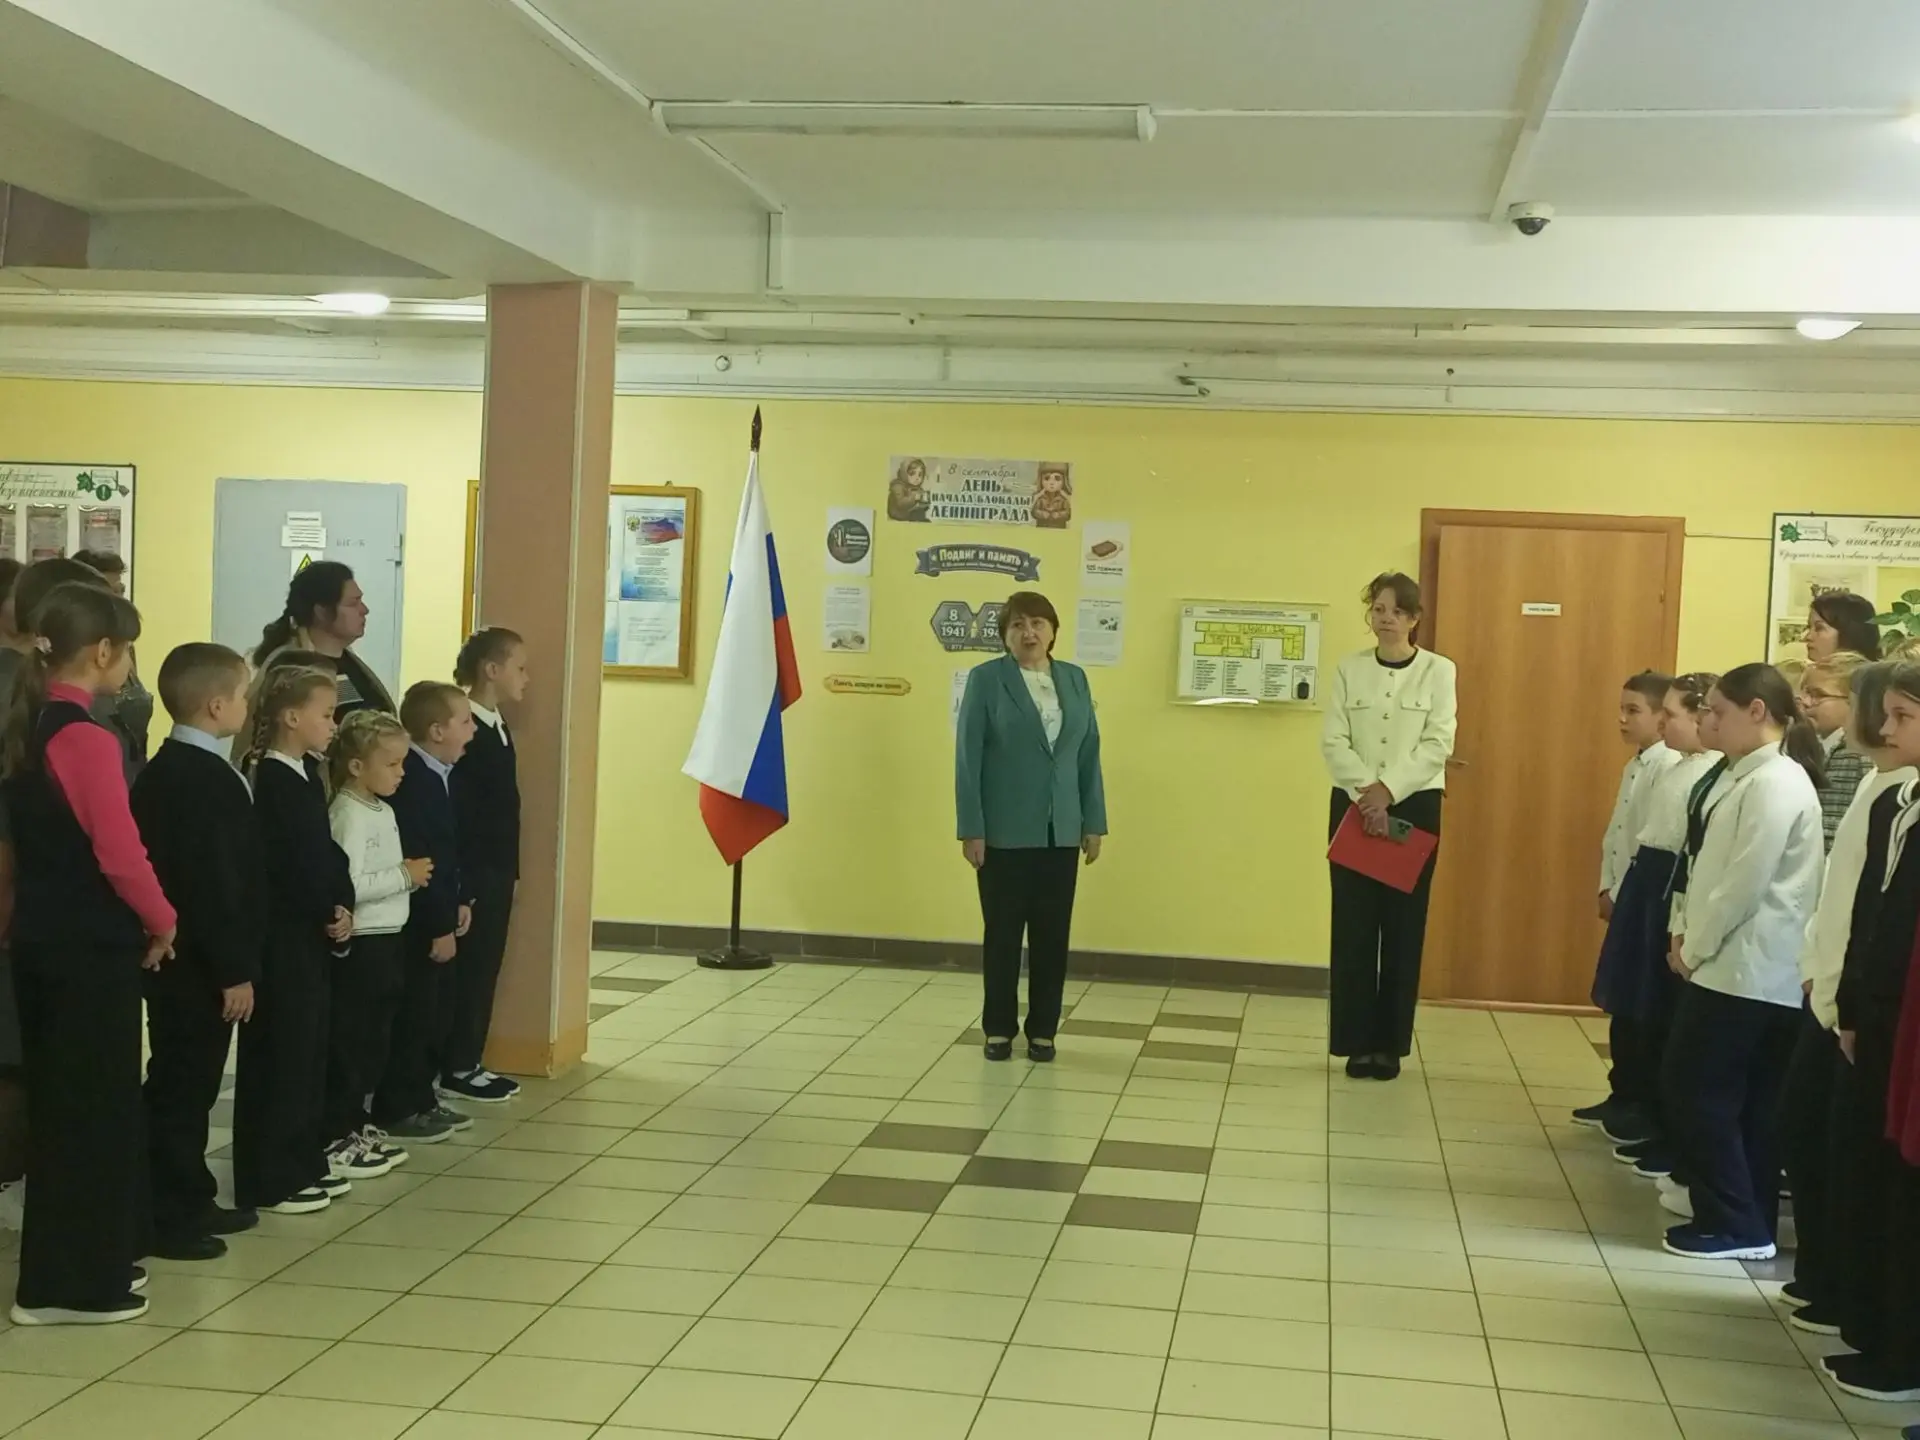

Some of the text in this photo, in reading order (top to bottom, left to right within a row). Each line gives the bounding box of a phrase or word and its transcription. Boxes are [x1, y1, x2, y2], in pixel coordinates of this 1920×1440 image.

[948, 463, 1017, 480] 8 сентября
[961, 479, 1002, 492] ДЕНЬ
[931, 493, 1032, 506] НАЧАЛА БЛОКАДЫ
[931, 505, 1030, 522] ЛЕНИНГРАДА
[939, 548, 1021, 566] Подвиг и память
[948, 608, 959, 621] 8
[940, 626, 965, 637] 1941
